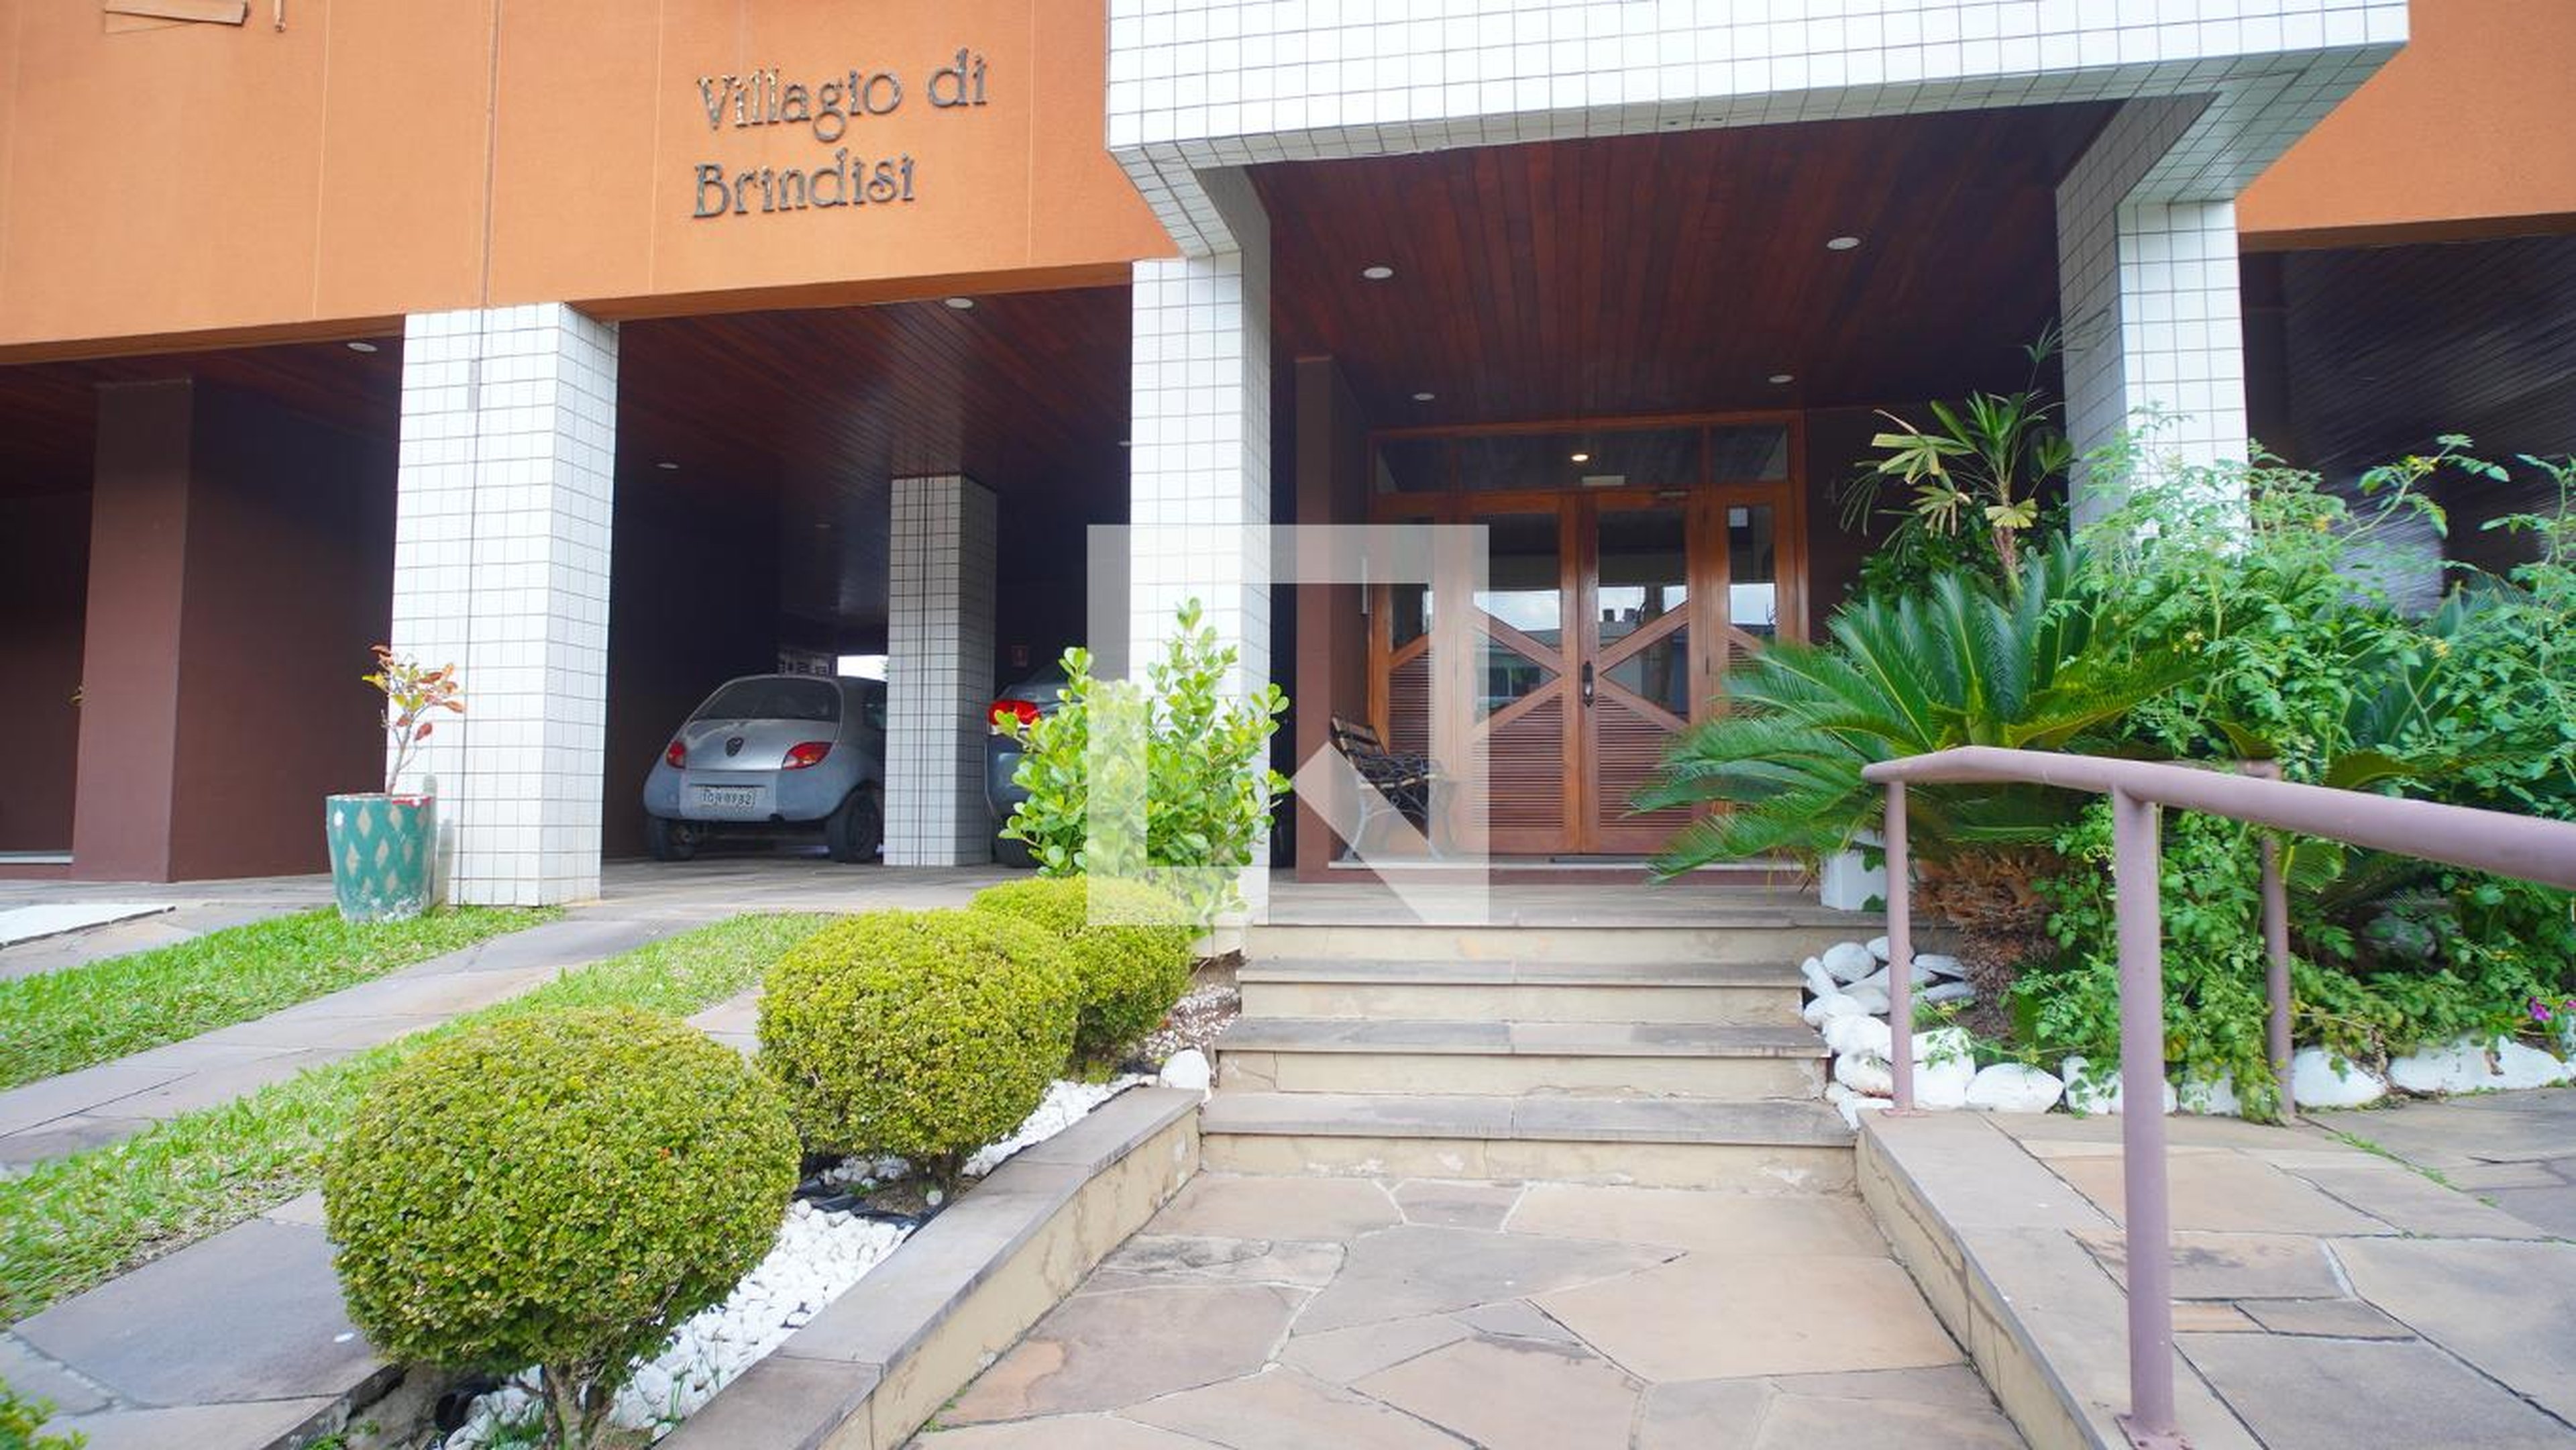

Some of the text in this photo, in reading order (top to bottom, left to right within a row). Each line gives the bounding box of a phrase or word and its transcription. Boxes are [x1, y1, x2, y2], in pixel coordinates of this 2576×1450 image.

[696, 47, 987, 143] Villagio di
[692, 147, 915, 218] Brindisi
